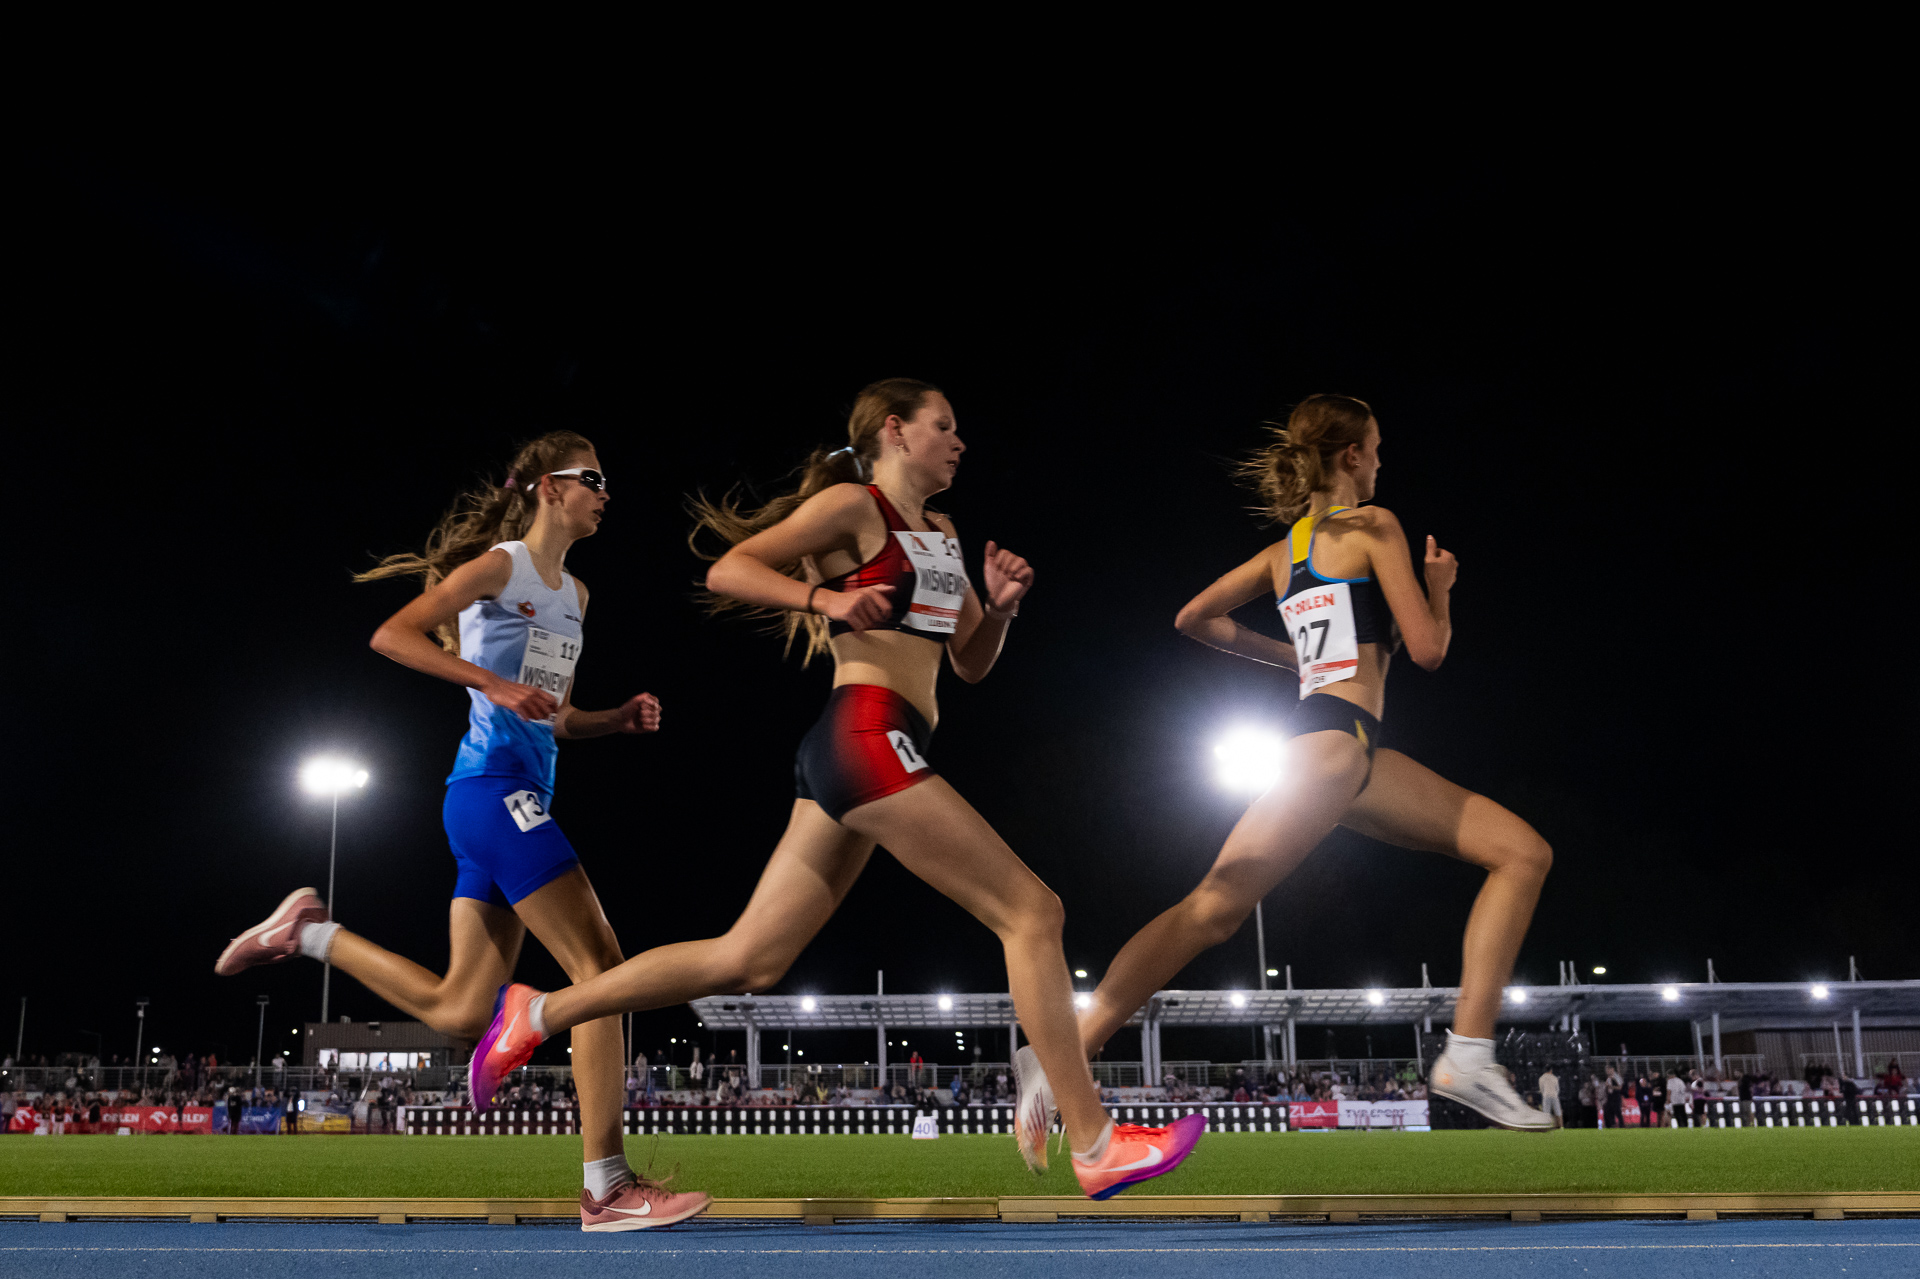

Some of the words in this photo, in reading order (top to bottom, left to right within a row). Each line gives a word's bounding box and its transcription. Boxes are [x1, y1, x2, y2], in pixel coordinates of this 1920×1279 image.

[1294, 592, 1335, 616] ORLEN
[511, 793, 545, 823] 13
[33, 1113, 73, 1124] OLN
[102, 1113, 140, 1123] ORLEN
[914, 1122, 930, 1135] 40
